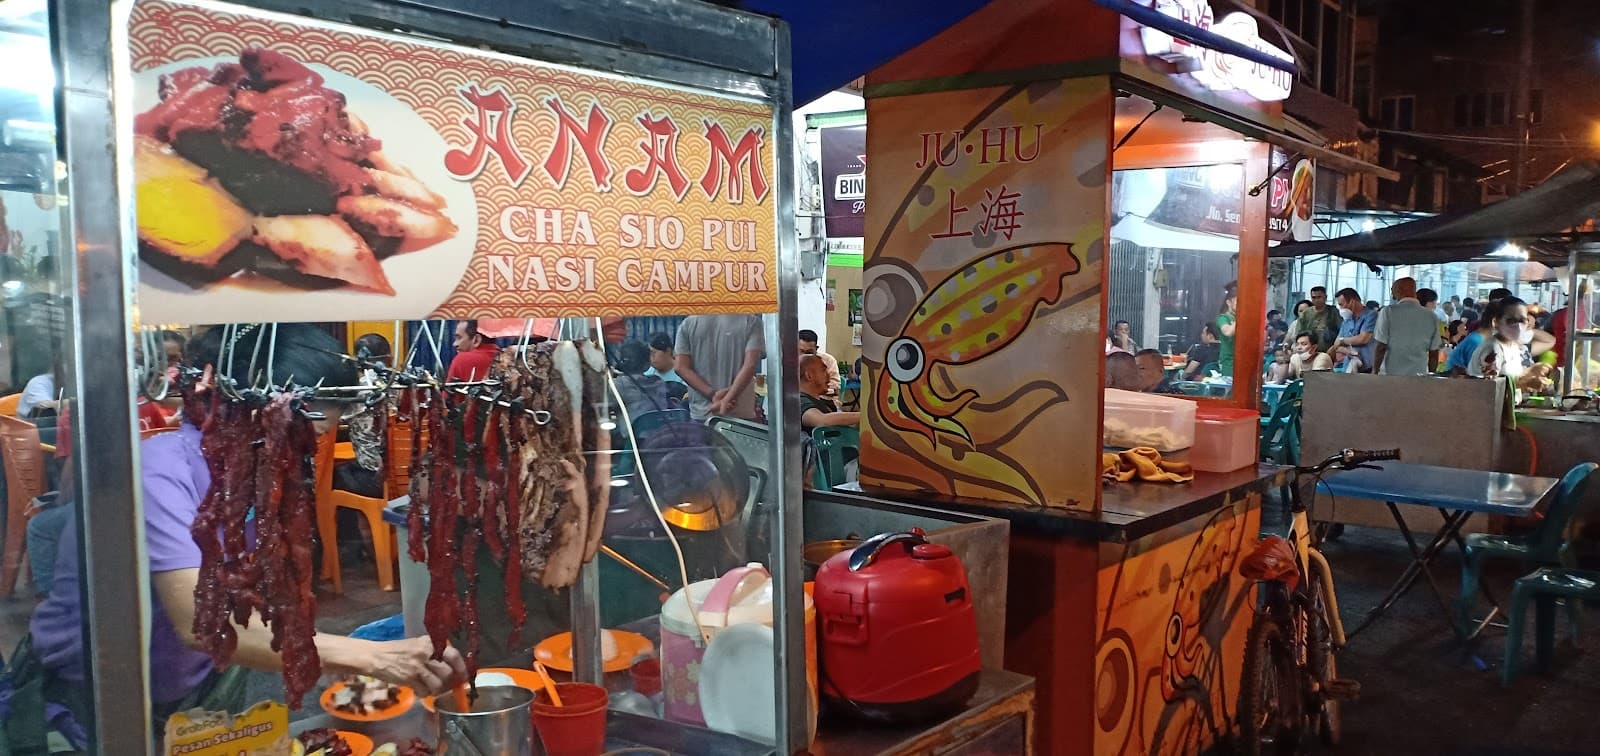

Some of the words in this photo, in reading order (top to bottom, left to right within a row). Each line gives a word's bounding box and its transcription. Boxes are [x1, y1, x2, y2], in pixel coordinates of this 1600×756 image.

[444, 85, 768, 202] ANAM
[499, 205, 598, 246] CHA
[619, 213, 684, 250] SIO
[702, 218, 757, 251] PUI
[930, 185, 1025, 241] 上海
[486, 255, 596, 291] NASI
[616, 258, 768, 293] CAMPUR
[172, 738, 211, 755] Pesan
[213, 721, 273, 745] Sekaligus
